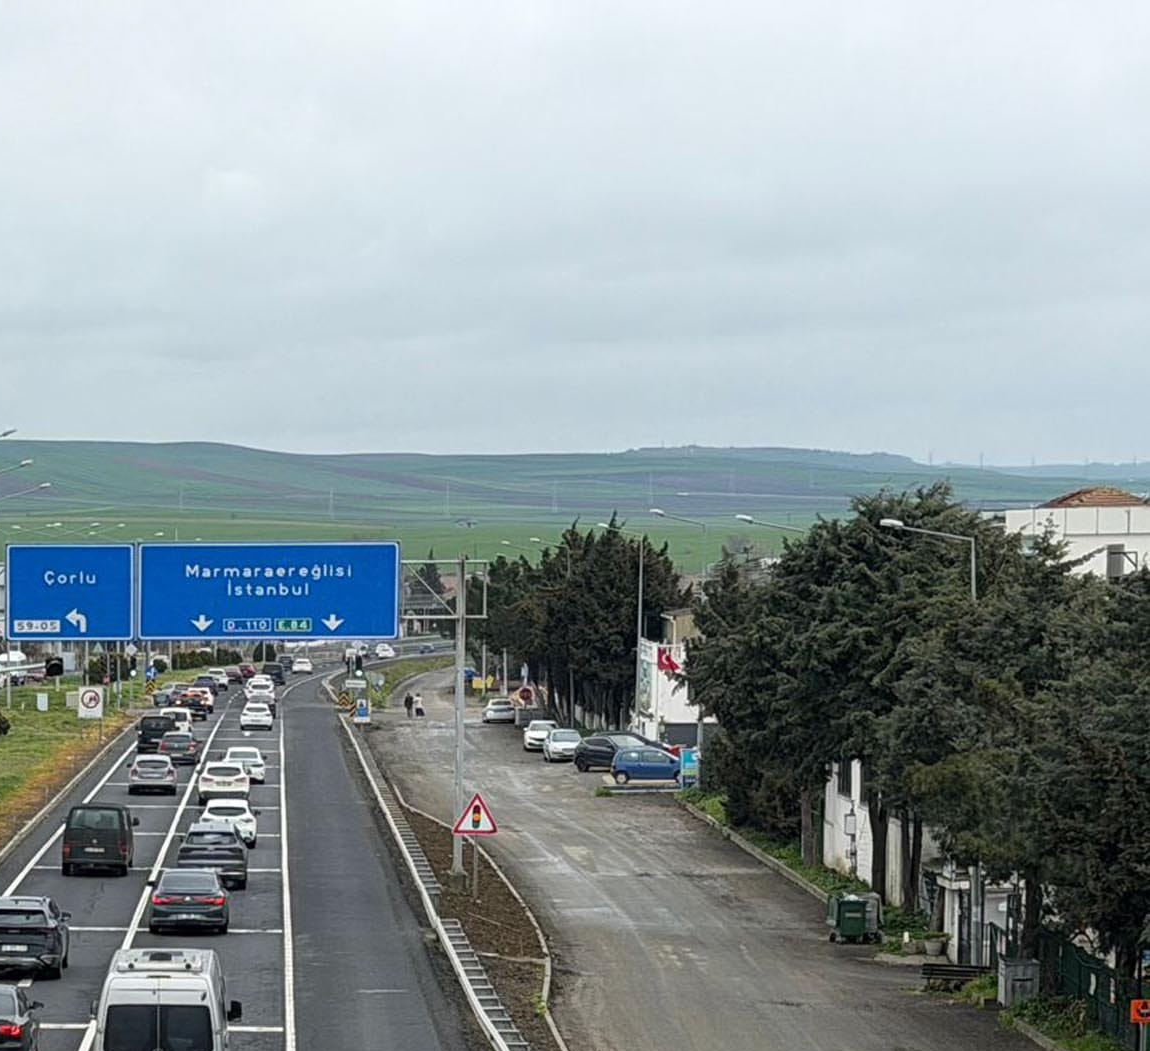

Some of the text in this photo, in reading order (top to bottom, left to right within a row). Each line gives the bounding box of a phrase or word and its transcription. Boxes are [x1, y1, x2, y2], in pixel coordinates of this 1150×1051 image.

[43, 570, 97, 586] Çorlu
[227, 579, 309, 596] İstanbul
[16, 621, 58, 631] 59-05
